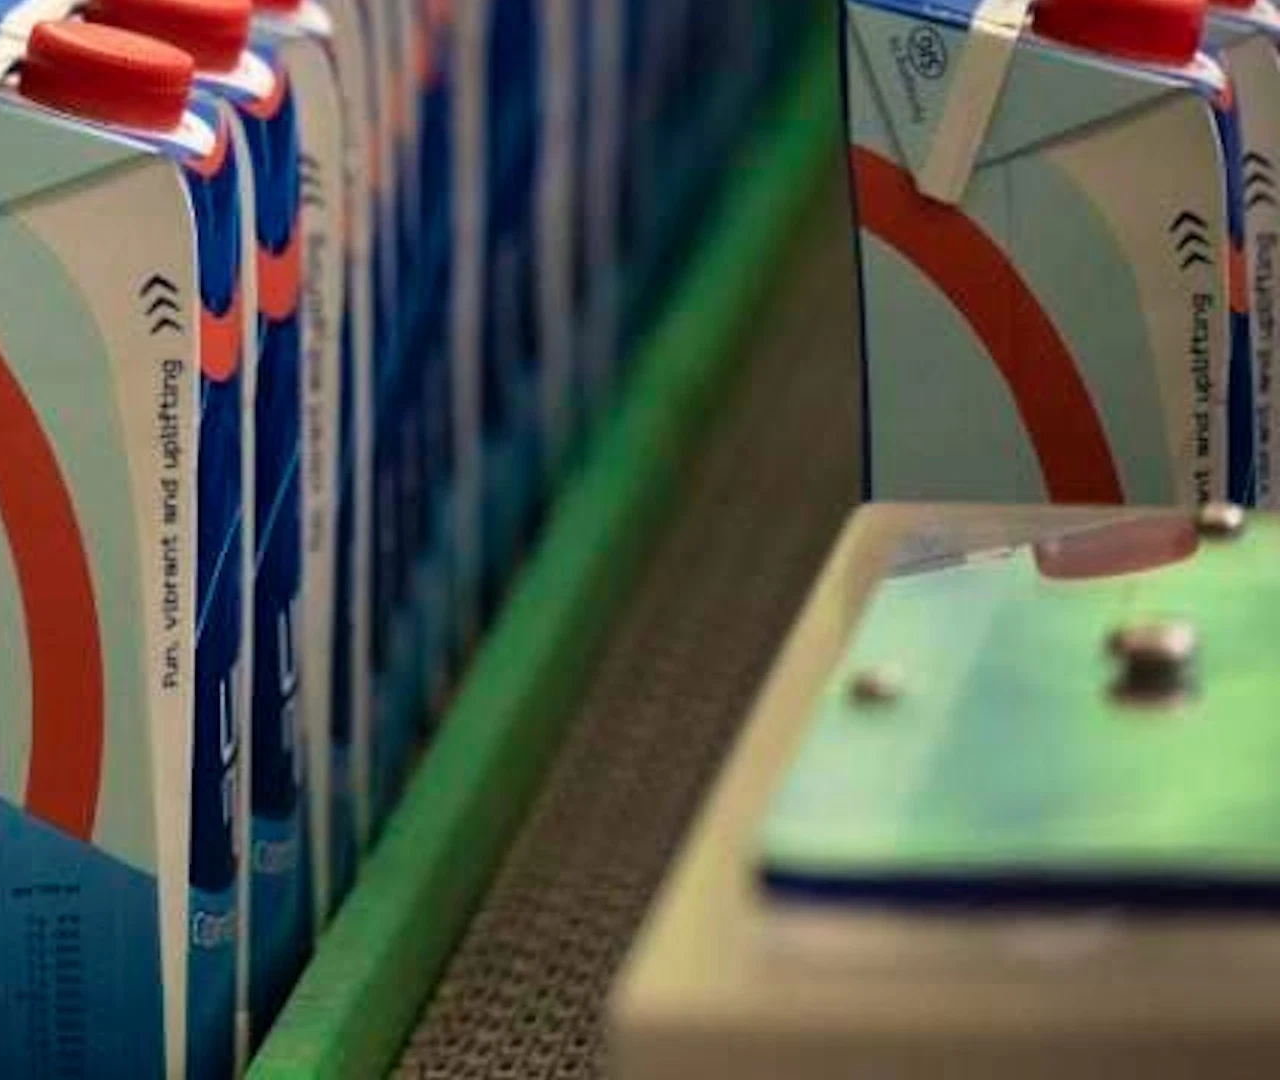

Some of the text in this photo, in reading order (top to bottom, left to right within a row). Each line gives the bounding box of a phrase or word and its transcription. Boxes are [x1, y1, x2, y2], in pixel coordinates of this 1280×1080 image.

[1189, 293, 1214, 403] uplifting
[156, 359, 185, 470] uplifting
[1193, 411, 1210, 458] and
[159, 477, 180, 526] and
[160, 533, 181, 632] vibrant
